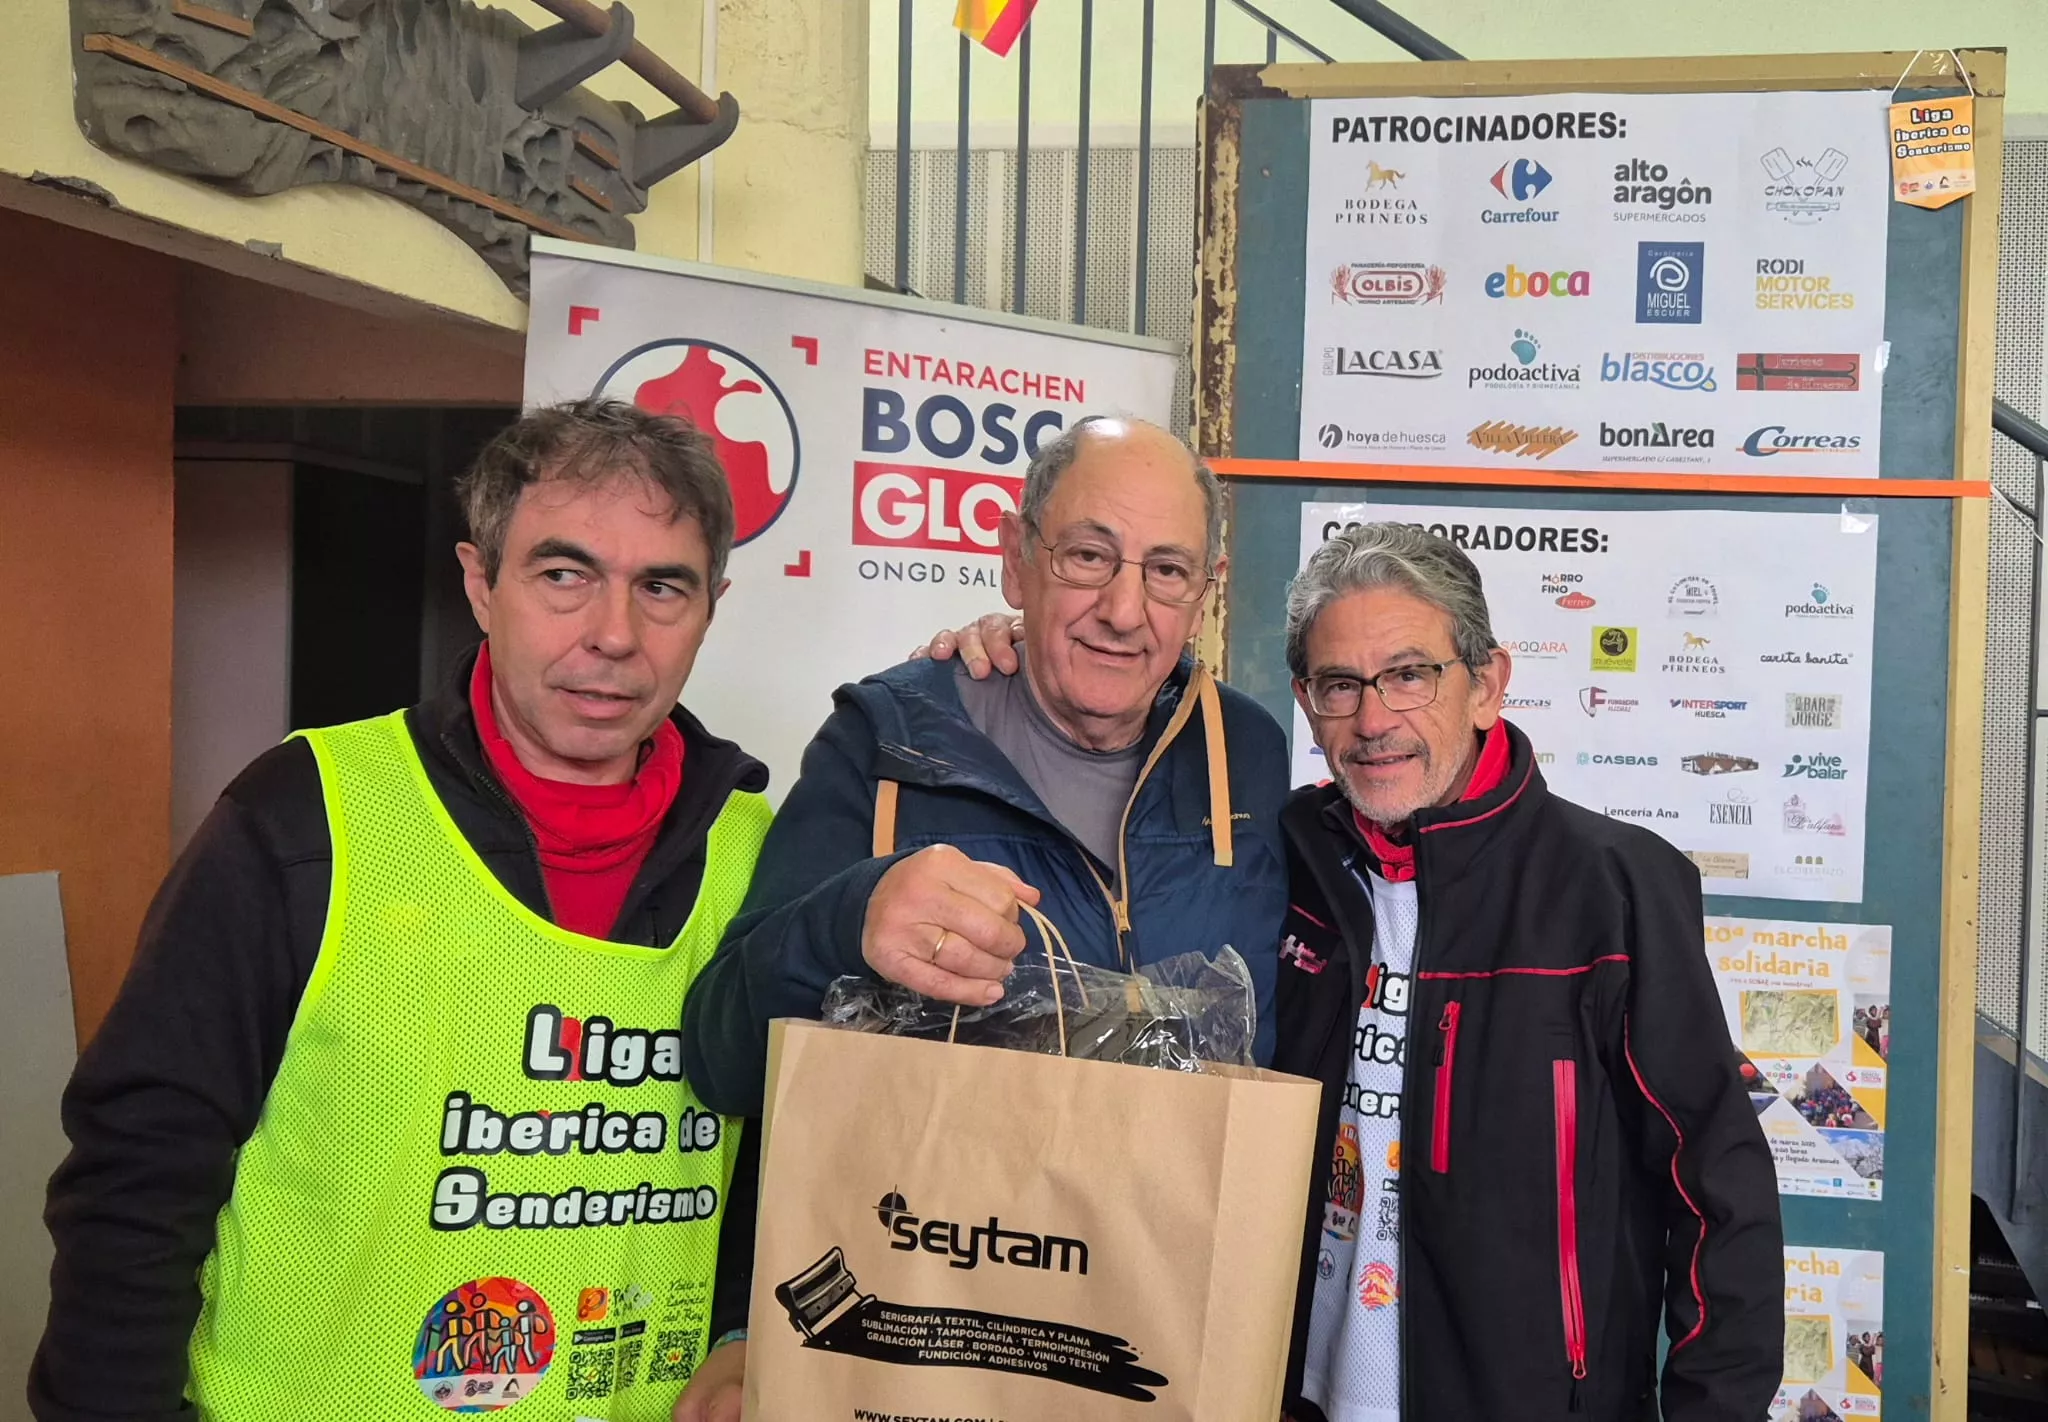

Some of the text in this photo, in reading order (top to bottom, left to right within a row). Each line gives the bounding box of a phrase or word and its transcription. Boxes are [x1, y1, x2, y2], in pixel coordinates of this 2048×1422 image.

[1911, 108, 1953, 124] Liga
[1332, 111, 1626, 143] PATROCINADORES:
[1896, 143, 1971, 158] Senderismo
[1614, 158, 1668, 182] alto
[1764, 186, 1844, 197] CHOKOPAN
[1345, 199, 1418, 210] BODEGA
[1335, 213, 1429, 225] PIRINEOS
[1481, 208, 1560, 224] Carrefour
[1613, 212, 1707, 223] SUPERMERCADOS
[1756, 259, 1804, 274] RODI
[1485, 264, 1590, 298] eboca
[1756, 276, 1831, 292] MOTOR
[1648, 293, 1691, 309] MIGUEL
[1756, 293, 1854, 310] SERVICES
[1647, 309, 1690, 317] ESCUER
[1336, 347, 1443, 375] LACASA
[1600, 352, 1706, 384] blasco
[864, 348, 1085, 404] ENTARACHEN
[1469, 363, 1580, 389] podoactiva
[862, 387, 1064, 466] BOSC
[1347, 430, 1446, 445] hoya de huesca
[1742, 426, 1861, 457] Correas
[860, 472, 1018, 548] GLO
[1322, 521, 1609, 553] CORADORES:
[858, 560, 946, 584] ONGD
[1541, 585, 1568, 594] FINO
[1785, 602, 1854, 618] podoactiva
[1501, 640, 1568, 654] SAQQARA
[1668, 655, 1719, 665] BODEGA
[1662, 664, 1726, 674] PIRINEOS
[1682, 699, 1748, 711] INTERSPORT
[1804, 696, 1826, 711] BAR
[1695, 711, 1726, 719] HUESCA
[1592, 754, 1659, 766] CASBAS
[1808, 752, 1842, 767] vive
[1807, 766, 1848, 780] balar
[1604, 806, 1679, 819] Lencería Ana
[1709, 803, 1753, 825] ESENCIA
[1753, 927, 1849, 951] marcha
[1718, 950, 1831, 978] solidaria
[523, 1004, 683, 1087] Liga
[679, 1106, 721, 1152] de
[430, 1165, 720, 1231] Senderismo
[1786, 1251, 1841, 1276] rcha
[880, 1310, 1091, 1347] SERIGRAFÍA TEXTIL, CILÍNDRICA Y PLANA
[861, 1319, 1110, 1363] SUBLIMACIÓN TAMPOGRAFÍA TERMOIMPRESIÓN
[866, 1332, 1101, 1373] GRABACIÓN LÁSER BORDADO VINILO TEXTIL
[918, 1349, 1049, 1372] FUNDICIÓN ADHESIVOS
